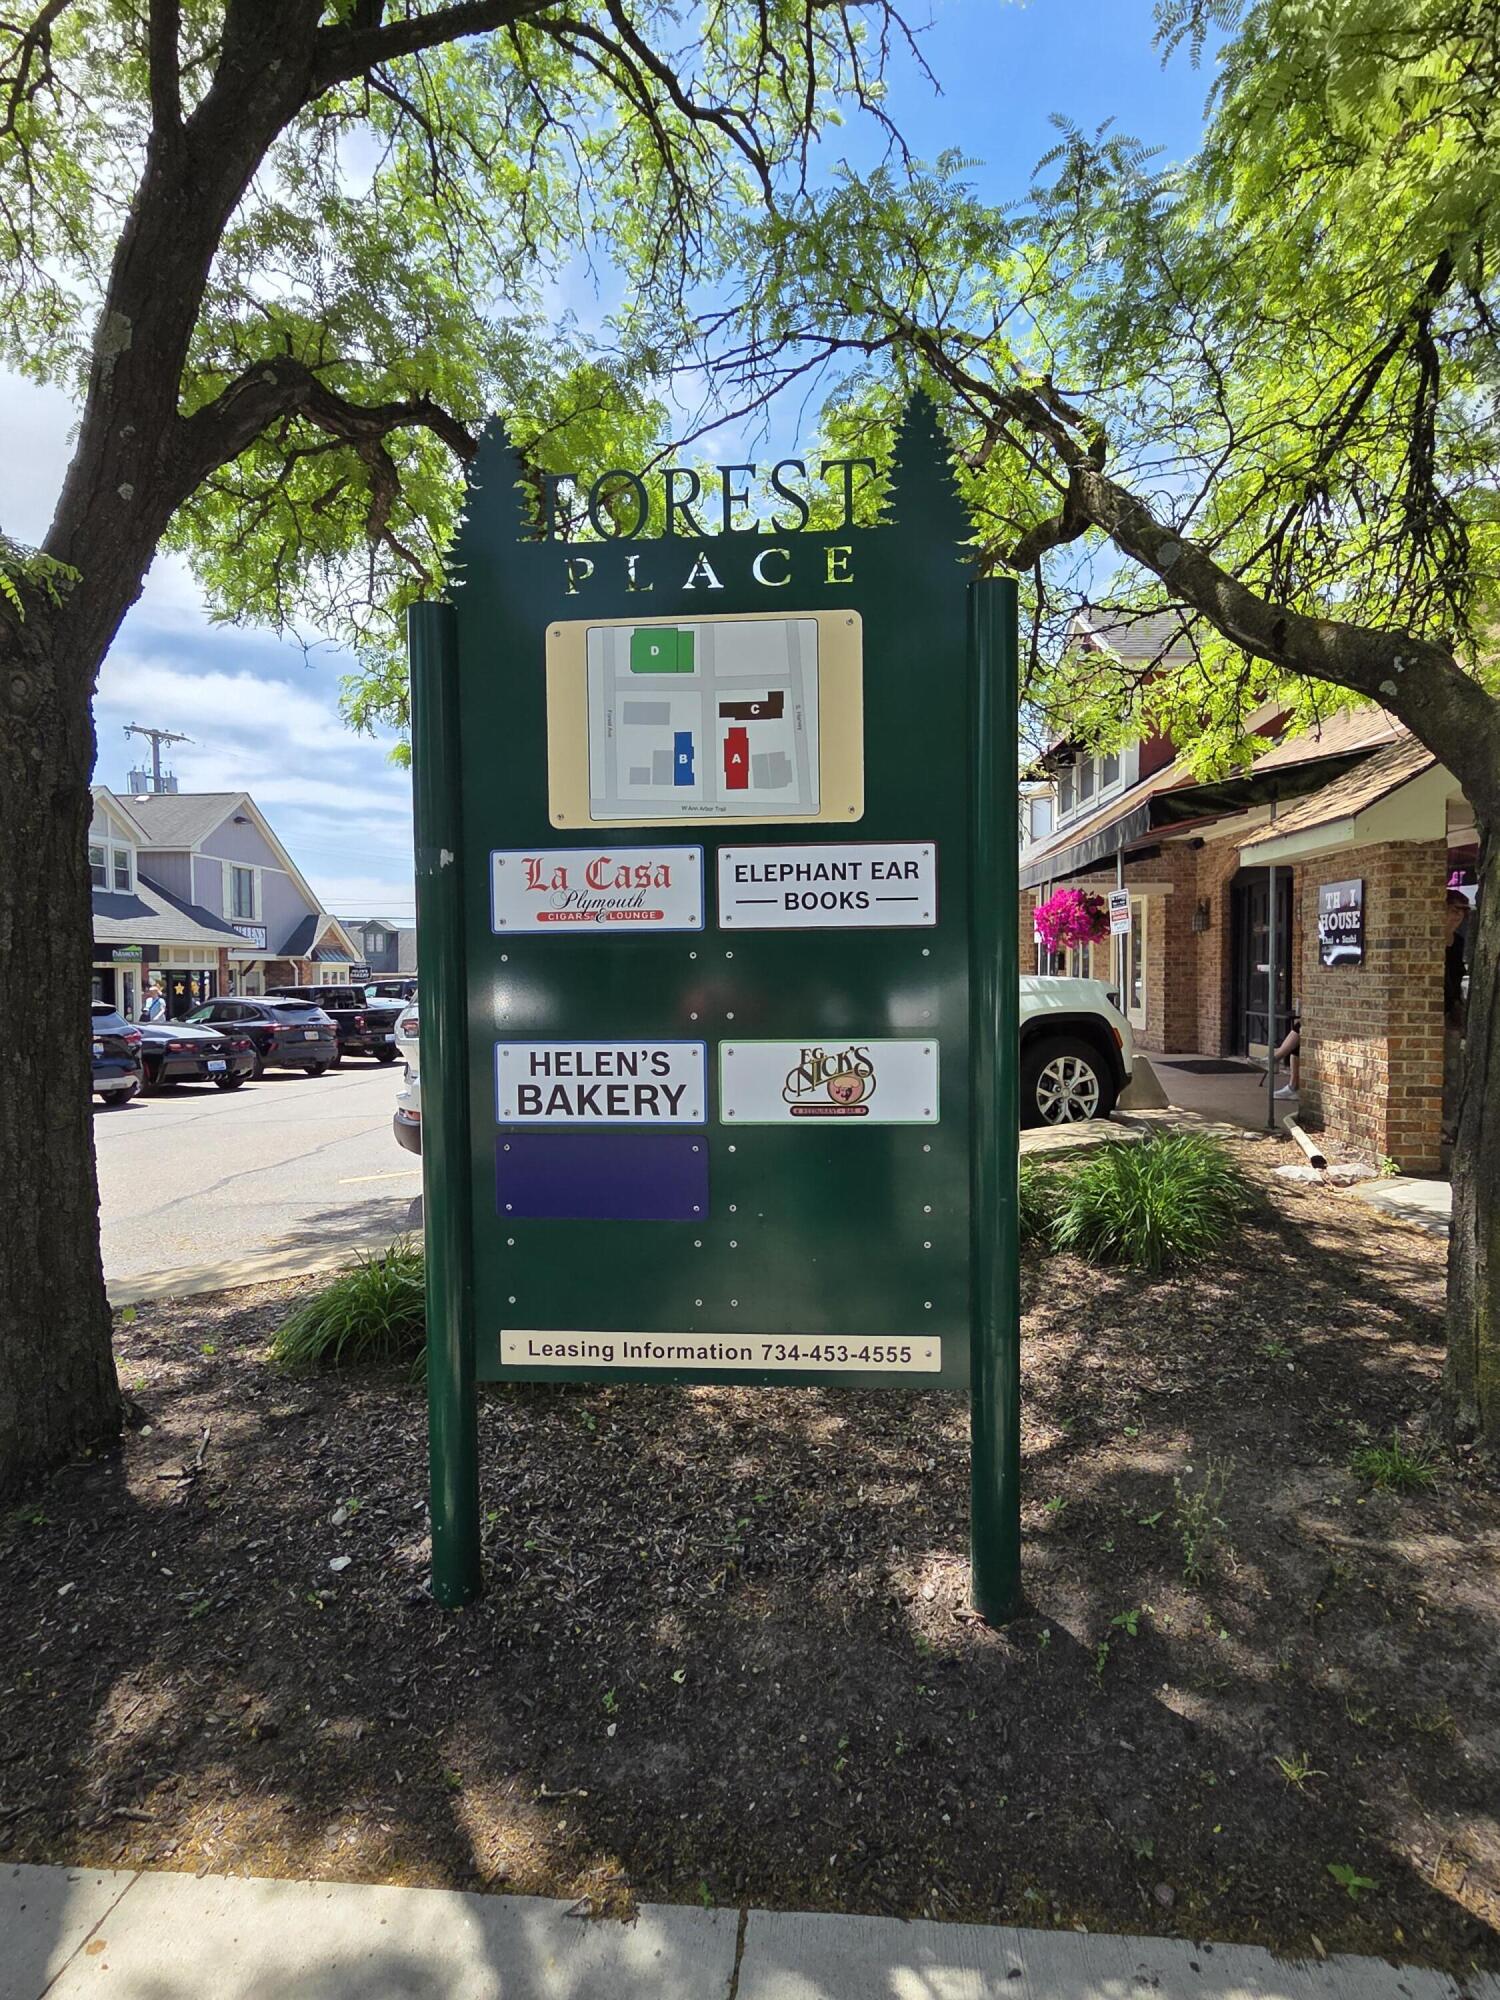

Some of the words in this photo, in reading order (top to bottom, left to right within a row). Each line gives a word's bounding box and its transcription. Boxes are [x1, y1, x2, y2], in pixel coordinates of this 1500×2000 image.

[543, 457, 877, 542] FOREST
[565, 546, 855, 595] PLACE
[650, 646, 660, 656] D
[751, 704, 760, 714] C
[679, 754, 688, 763] B
[732, 754, 741, 763] A
[521, 856, 569, 892] La
[586, 856, 672, 892] Casa
[735, 862, 862, 883] ELEPHANT
[871, 861, 919, 880] EAR
[550, 888, 647, 914] Plymouth
[784, 891, 870, 911] BOOKS
[548, 912, 591, 921] CIGARS
[609, 911, 657, 920] LOUNGE
[1319, 911, 1361, 931] HOUSE
[529, 1050, 671, 1077] HELEN'S
[796, 1046, 874, 1097] NICK'S
[517, 1084, 687, 1116] BAKERY
[528, 1339, 614, 1361] Leasing
[623, 1341, 752, 1360] Information
[761, 1344, 912, 1363] 734-453-4555
